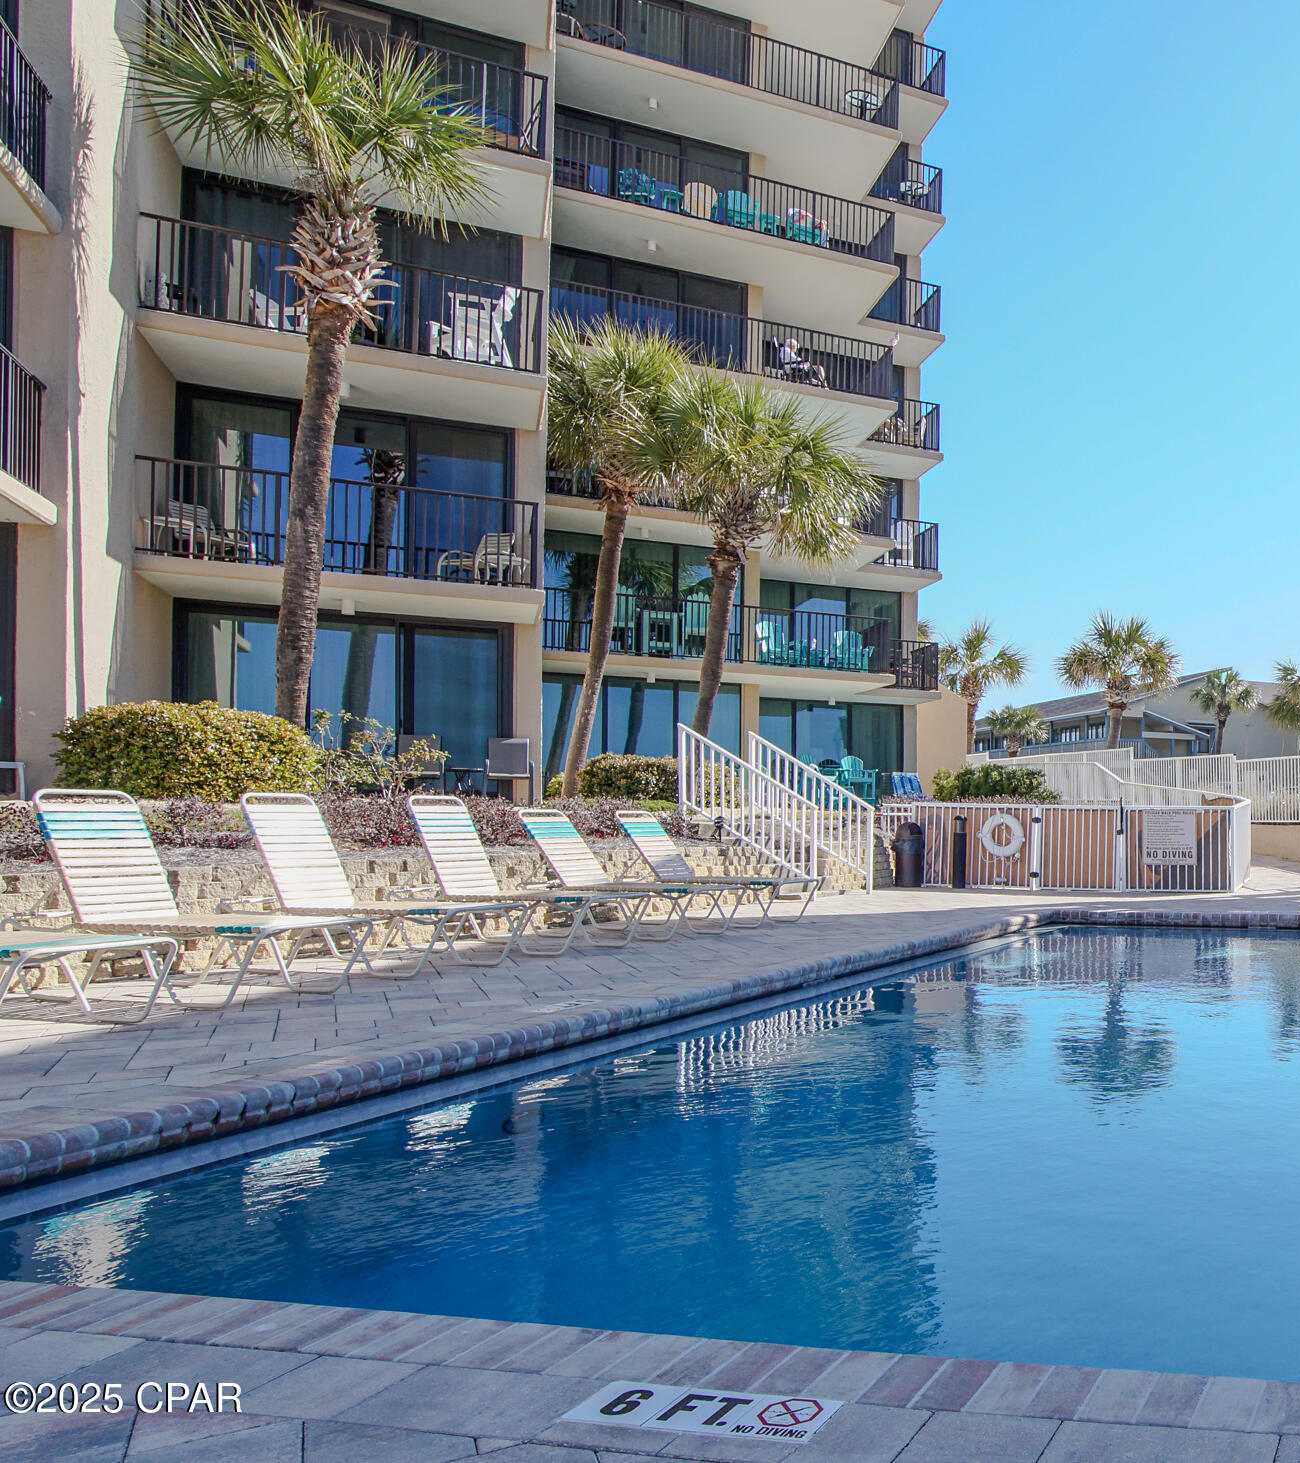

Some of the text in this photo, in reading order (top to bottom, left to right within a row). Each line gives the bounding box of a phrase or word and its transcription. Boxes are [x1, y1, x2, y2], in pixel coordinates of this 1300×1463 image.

[599, 1389, 753, 1427] 6 FT.
[731, 1424, 808, 1439] NO DIVING
